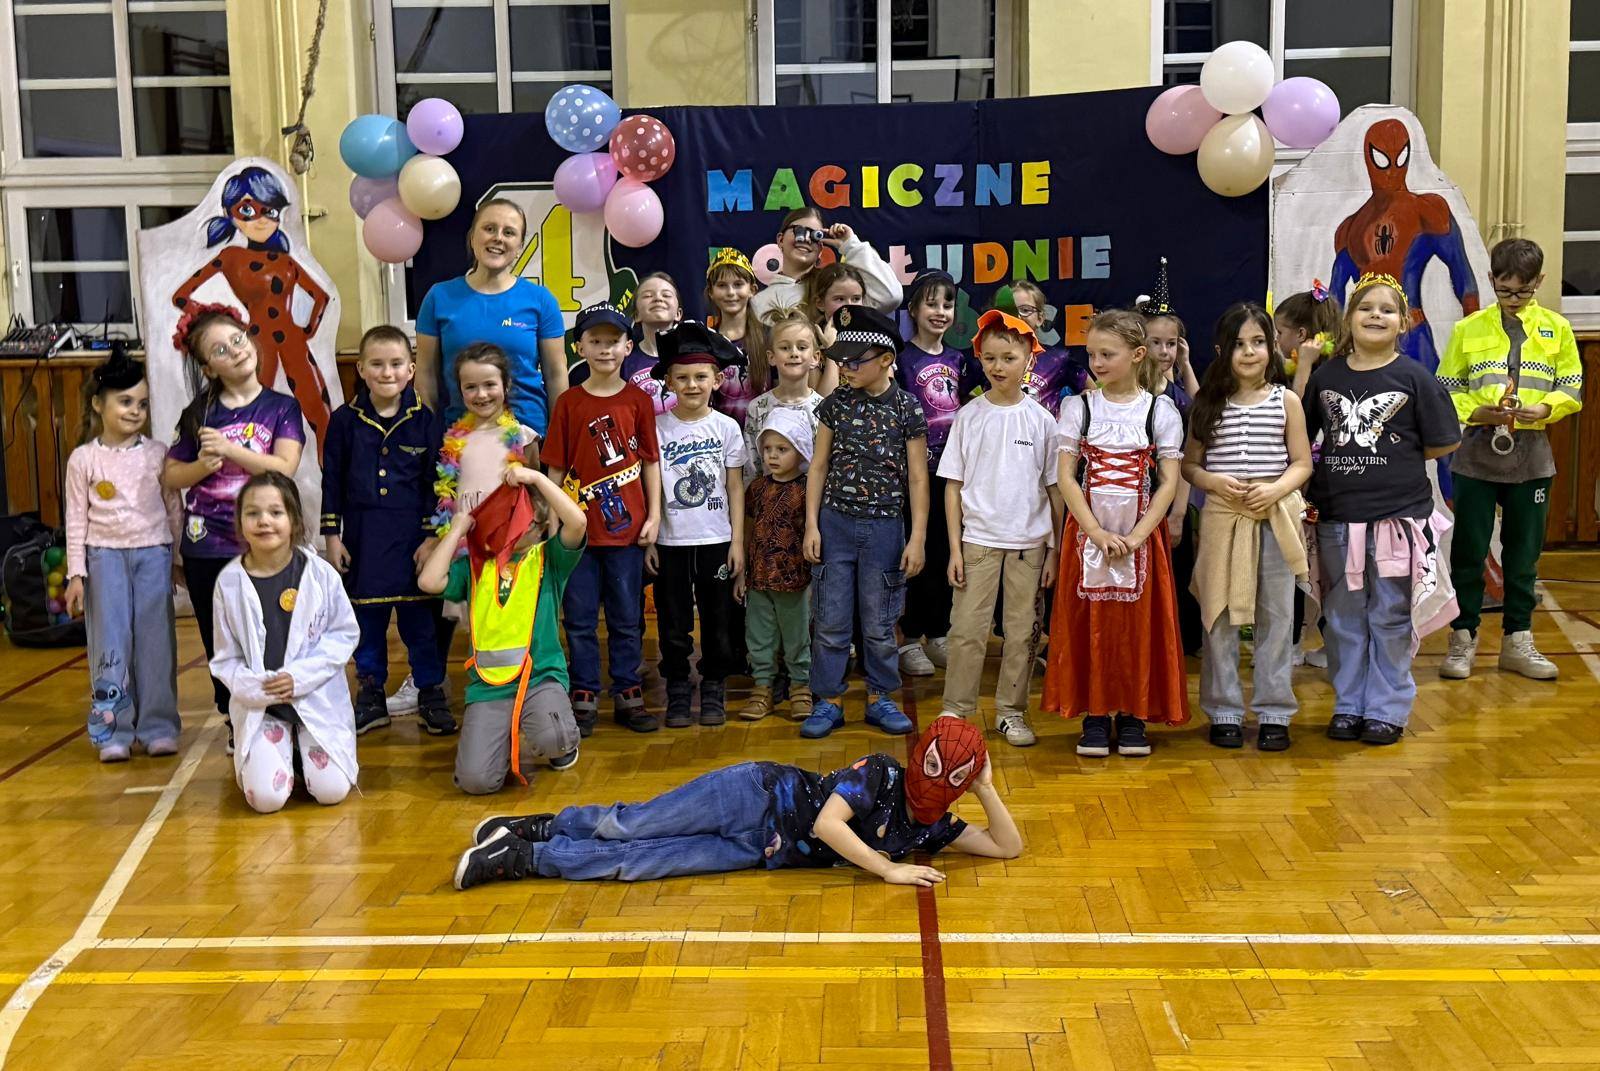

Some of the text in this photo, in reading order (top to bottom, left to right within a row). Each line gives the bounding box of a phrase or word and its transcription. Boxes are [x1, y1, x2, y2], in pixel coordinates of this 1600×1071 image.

[707, 160, 1051, 212] MAGICZNE
[708, 235, 1111, 286] OŁUDNIE
[660, 437, 723, 461] Exercise
[1331, 462, 1366, 475] Everyday
[1341, 456, 1355, 465] ON
[1358, 456, 1388, 465] VIBIN
[1534, 488, 1546, 503] 85
